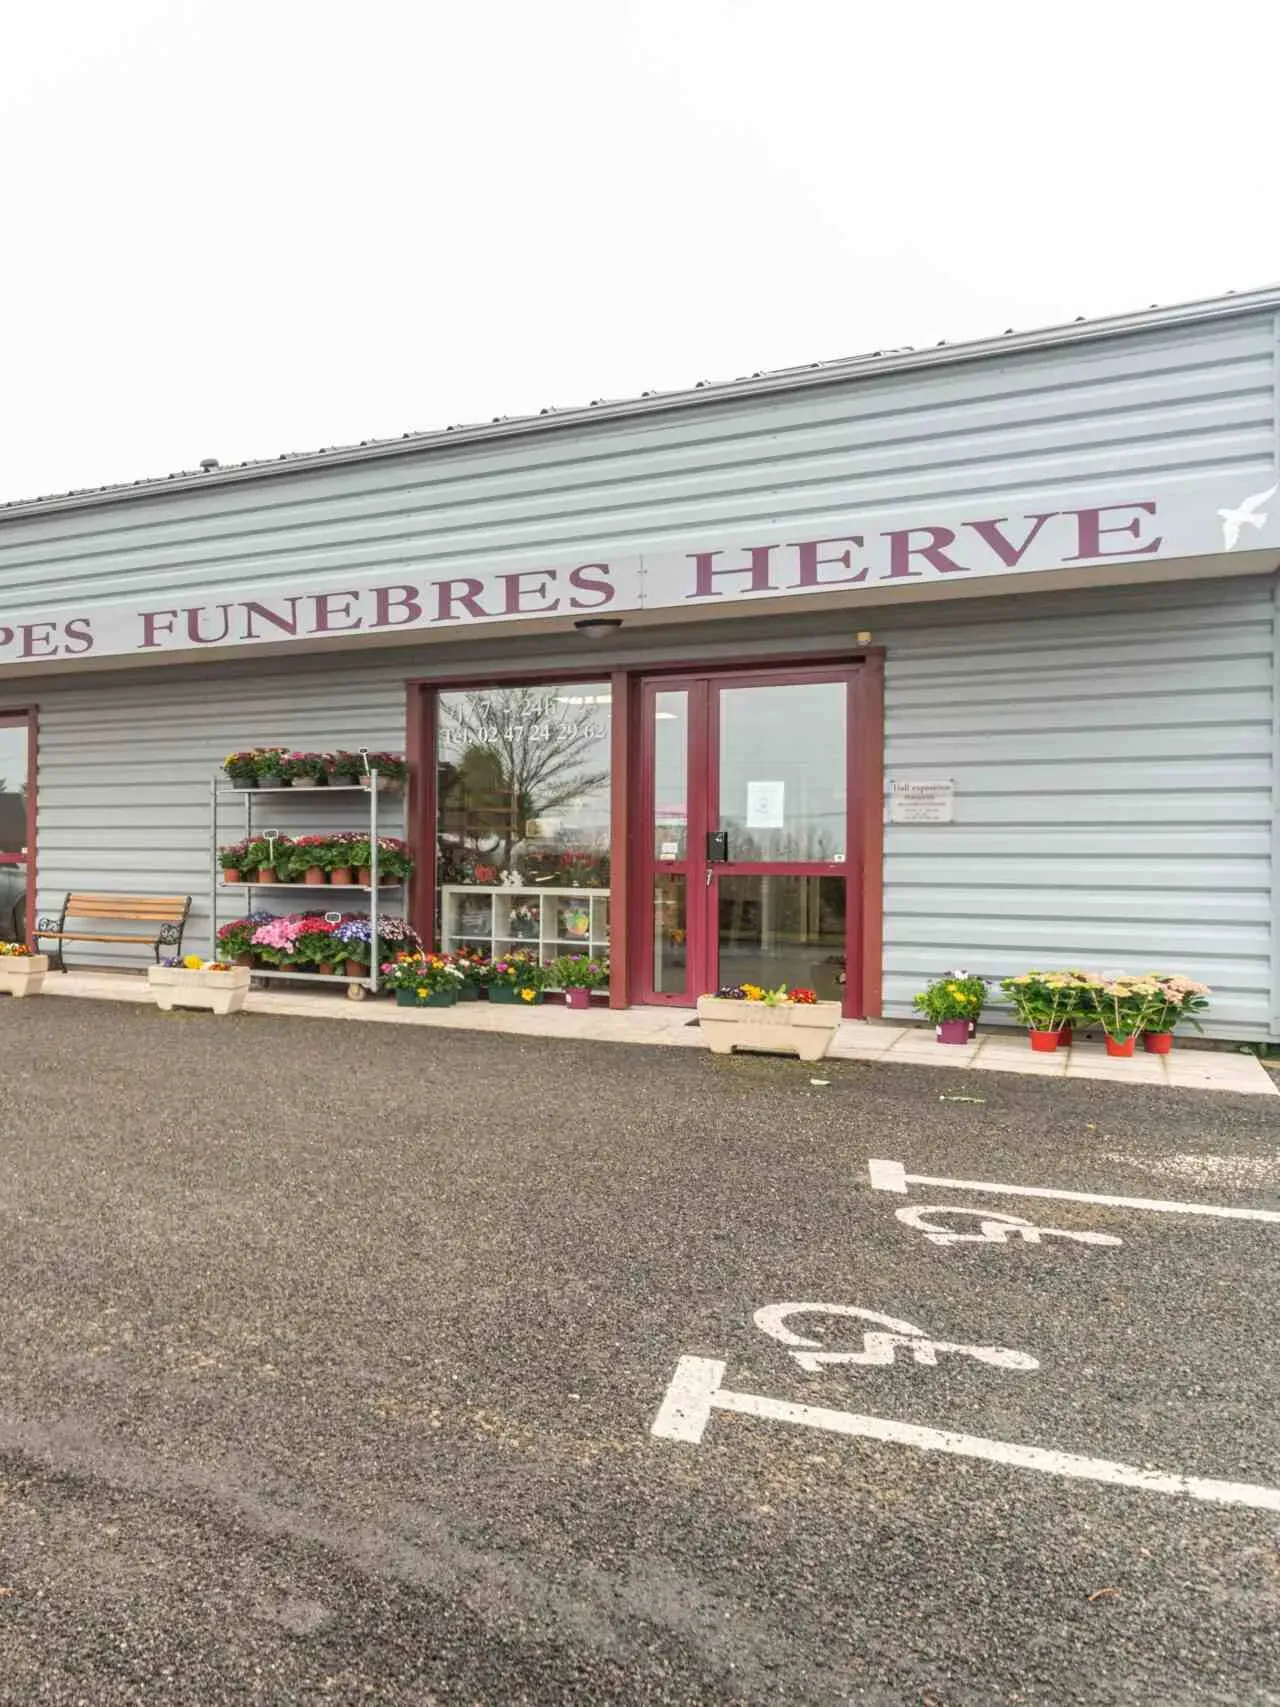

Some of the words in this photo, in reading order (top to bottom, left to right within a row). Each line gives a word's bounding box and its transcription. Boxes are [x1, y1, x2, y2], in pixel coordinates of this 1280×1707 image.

[137, 562, 616, 648] FUNEBRES
[685, 501, 1163, 600] HERVE
[479, 726, 498, 743] 02
[503, 725, 524, 742] 47
[529, 724, 550, 741] 24
